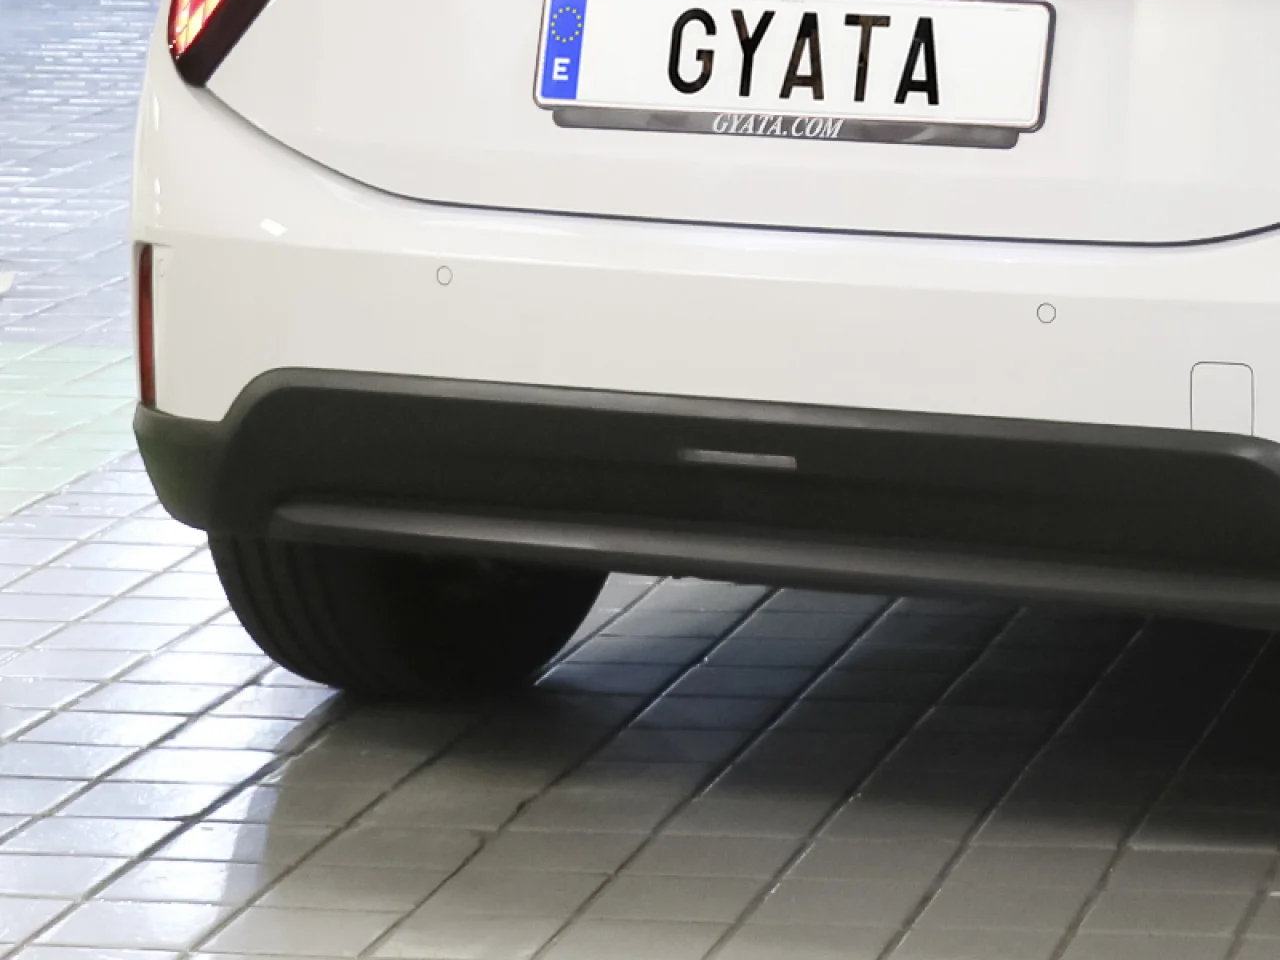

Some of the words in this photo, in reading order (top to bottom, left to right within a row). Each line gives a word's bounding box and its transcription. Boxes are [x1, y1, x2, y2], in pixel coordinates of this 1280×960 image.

[552, 57, 571, 81] E
[668, 7, 940, 106] GYATA
[712, 113, 845, 139] GYATA.COM
